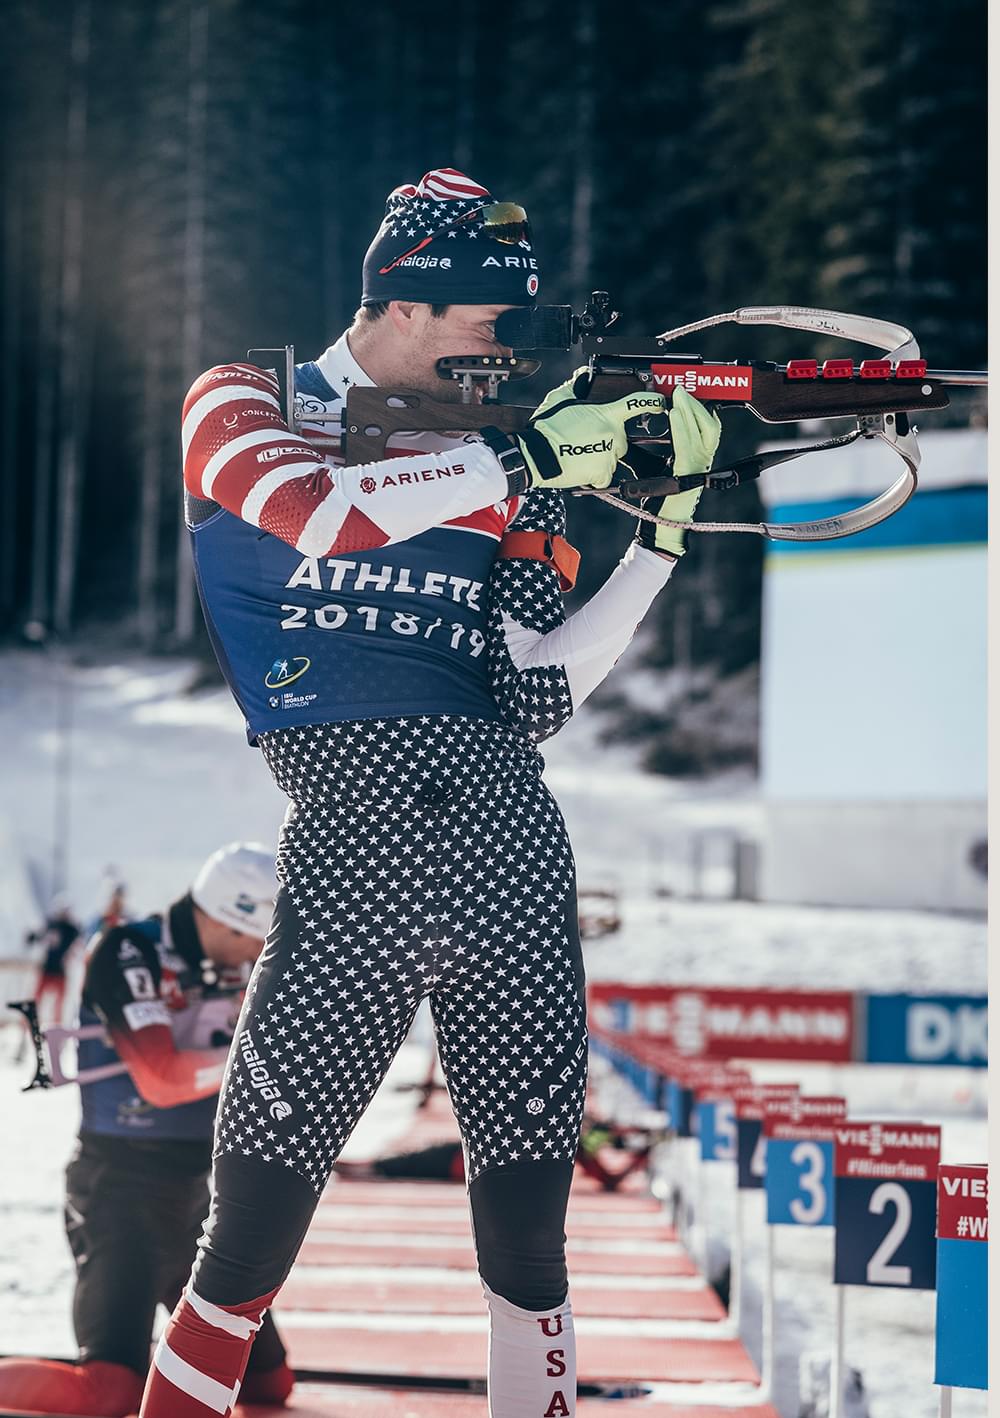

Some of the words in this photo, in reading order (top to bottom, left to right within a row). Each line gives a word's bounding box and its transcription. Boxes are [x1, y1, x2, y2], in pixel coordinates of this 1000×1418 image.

[653, 371, 749, 392] VIESSMANN
[381, 463, 466, 489] ARIENS
[285, 557, 484, 612] ATHLETE
[280, 604, 486, 658] 2018/19
[239, 1028, 282, 1101] maloja
[836, 1124, 939, 1155] VIESSMANN
[789, 1142, 828, 1224] 3
[942, 1176, 988, 1198] VIE
[866, 1182, 913, 1286] 2
[536, 1313, 570, 1418] USA
